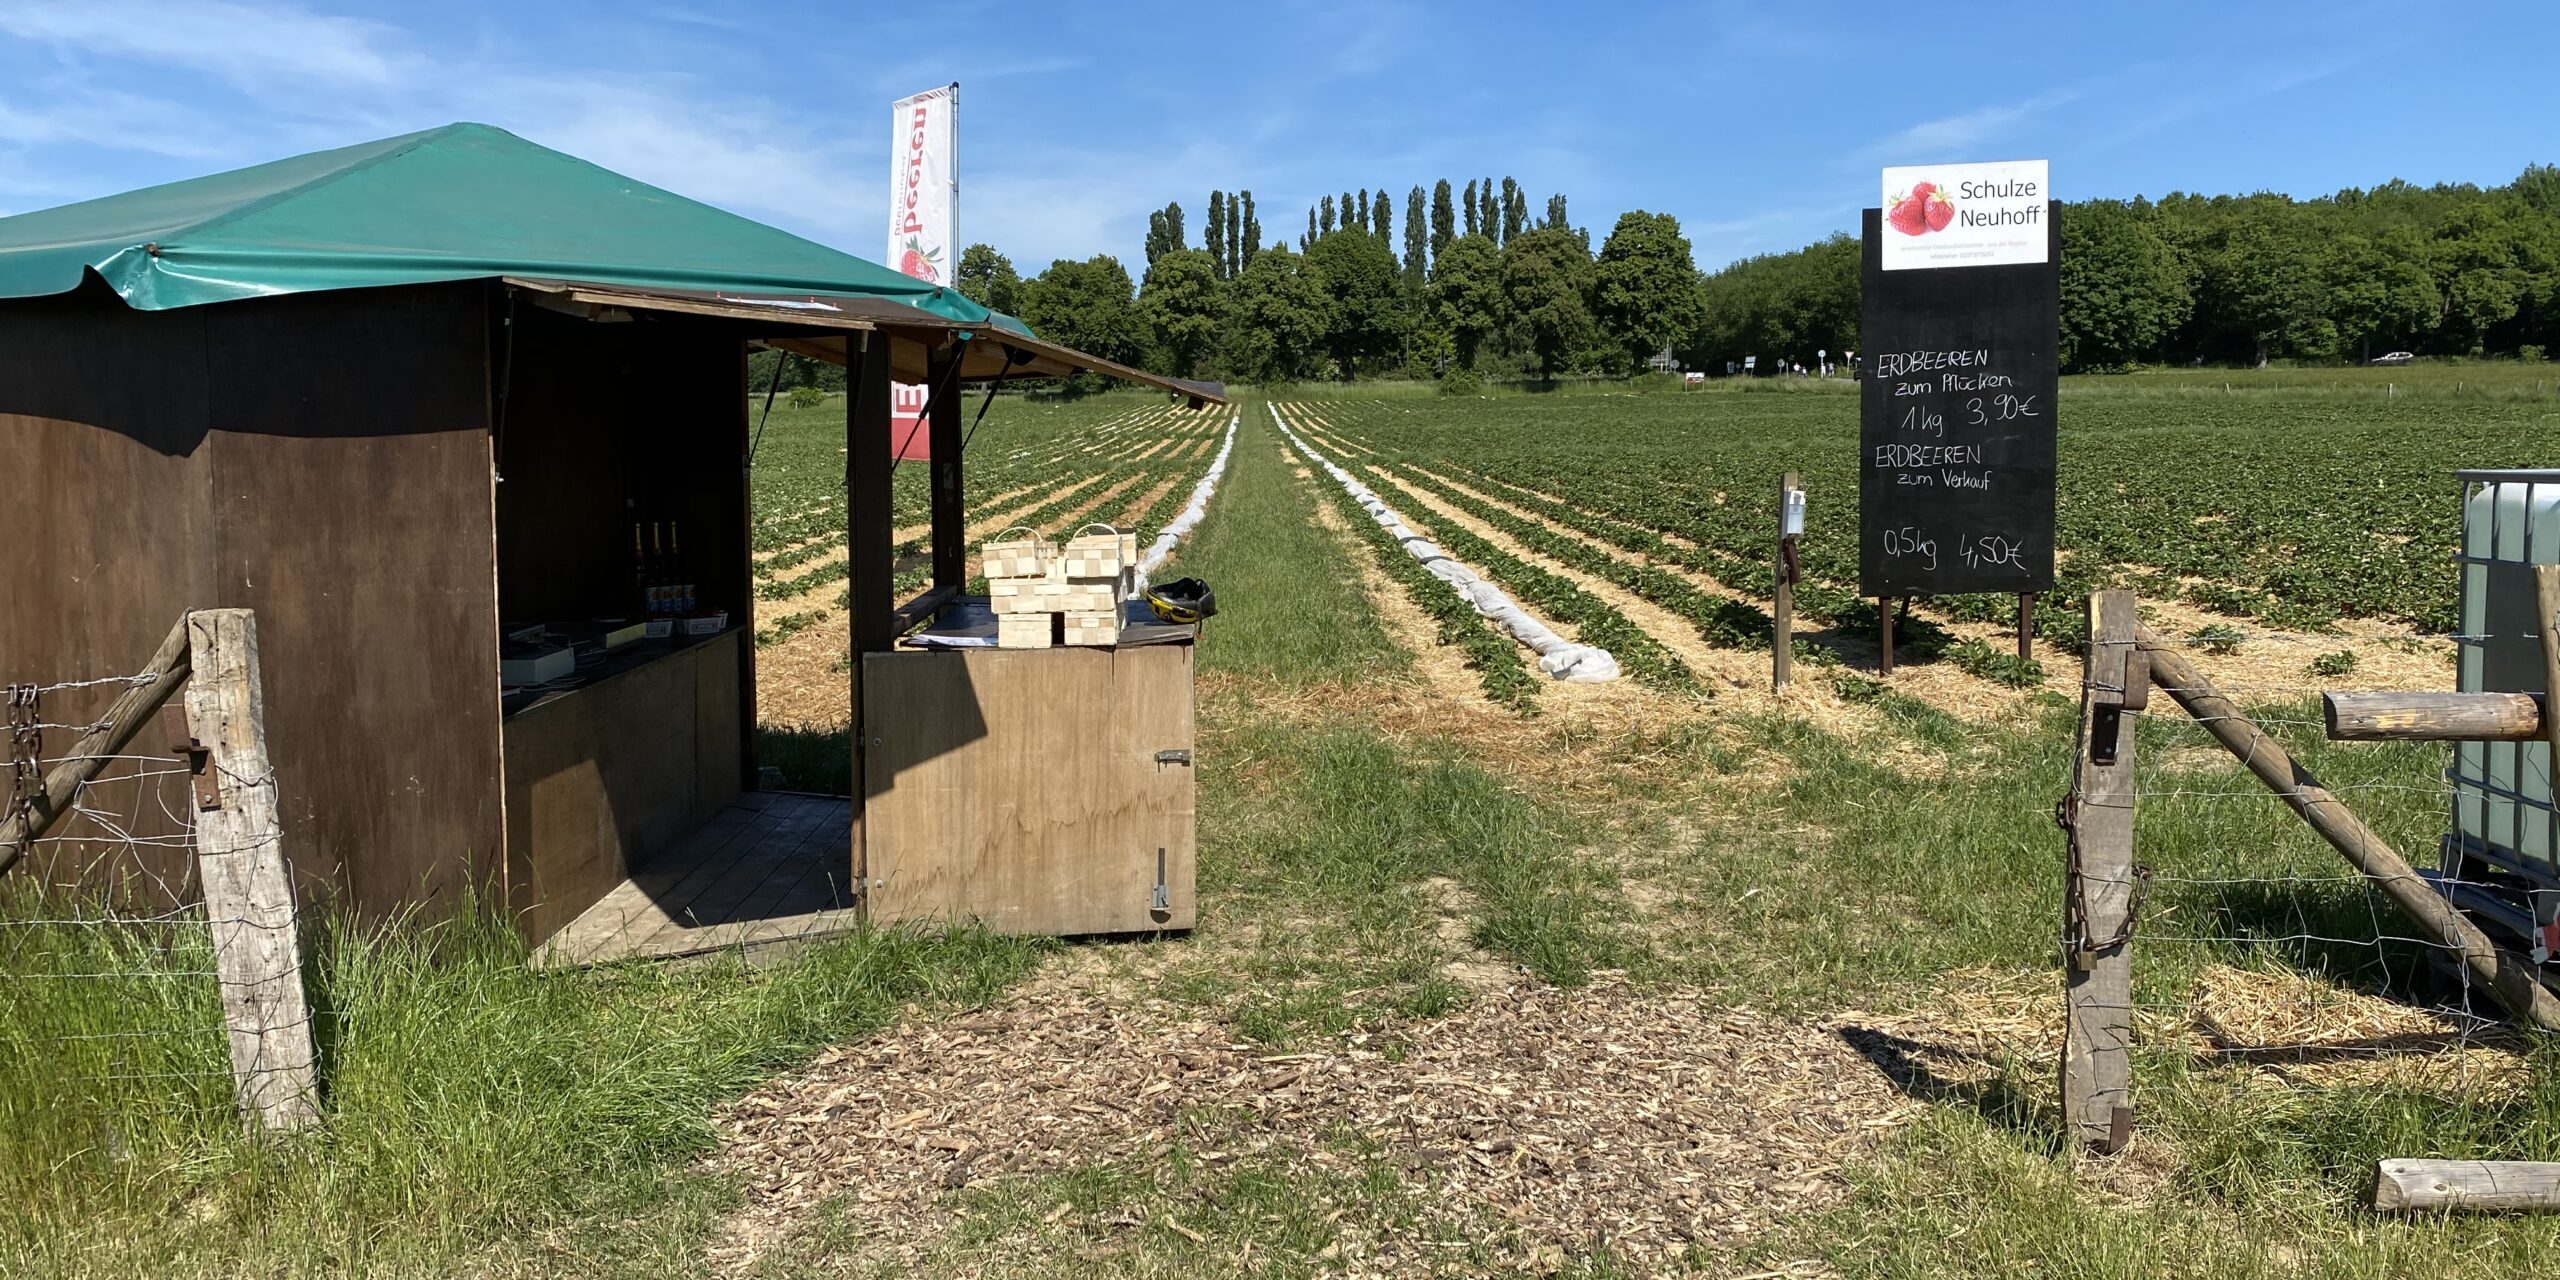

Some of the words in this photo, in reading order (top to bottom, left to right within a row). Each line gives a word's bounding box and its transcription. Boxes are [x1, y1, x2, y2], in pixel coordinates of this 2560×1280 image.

[1960, 179, 2037, 200] Schulze
[1961, 205, 2041, 228] Neuhoff
[1877, 349, 1988, 379] ERDBEEREN
[1895, 381, 1932, 396] zum
[1942, 372, 2014, 393] Pflücken
[1966, 392, 2039, 427] 3,90€
[1875, 443, 1981, 468] ERDBEEREN
[1897, 472, 1933, 486] zum
[1941, 468, 1993, 491] Verkauf
[1959, 533, 2027, 571] 4,50€
